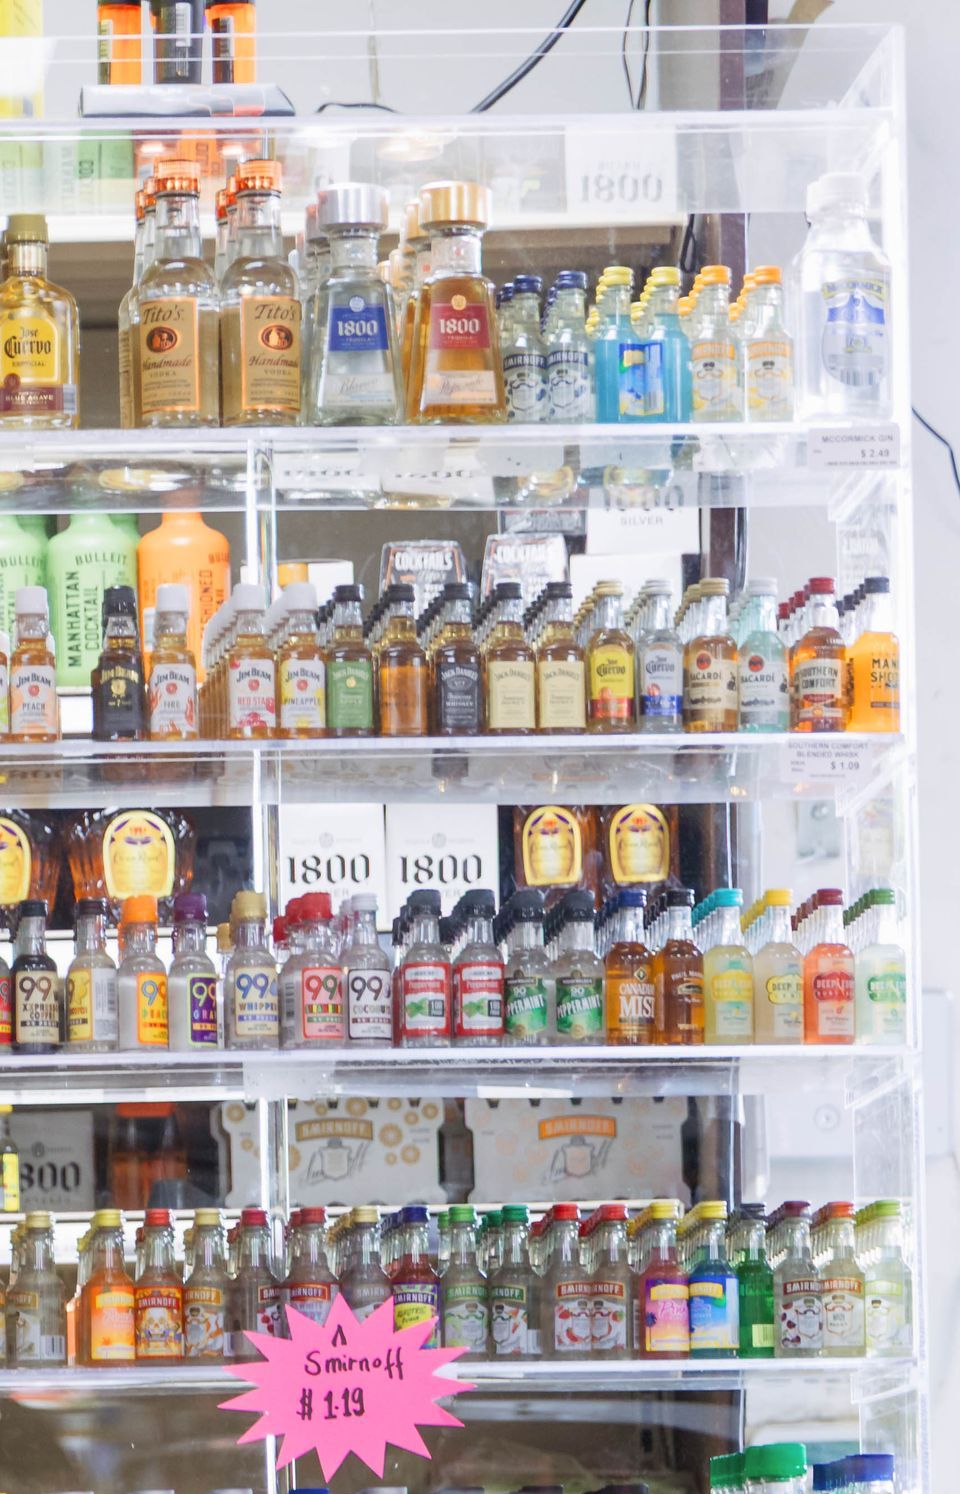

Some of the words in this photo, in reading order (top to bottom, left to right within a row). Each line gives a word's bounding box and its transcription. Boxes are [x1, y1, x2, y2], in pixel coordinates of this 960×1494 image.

[142, 303, 185, 326] Tito's
[440, 318, 480, 336] 1800
[337, 319, 378, 337] 1800
[3, 337, 52, 360] Cuervo
[821, 434, 873, 443] MCCORMICK
[877, 433, 894, 442] GIN
[395, 551, 454, 571] COCKTAILS
[67, 570, 82, 668] MANHATTAN
[84, 585, 100, 660] COCKTAIL
[787, 741, 822, 750] SOUTHERN
[824, 741, 869, 750] COMFORT
[796, 752, 830, 760] BLENDED
[832, 751, 860, 760] WHISK
[287, 853, 371, 885] 1800
[399, 853, 483, 885] 1800
[18, 976, 53, 1003] 99
[236, 972, 269, 999] 99
[305, 973, 339, 1000] 99
[350, 975, 383, 1002] 99
[301, 1121, 369, 1140] SMIRNOFF
[544, 1118, 614, 1136] SMIRNOFF
[303, 1346, 404, 1382] Smirnoff
[295, 1388, 314, 1421] $
[323, 1387, 365, 1420] 1.19
